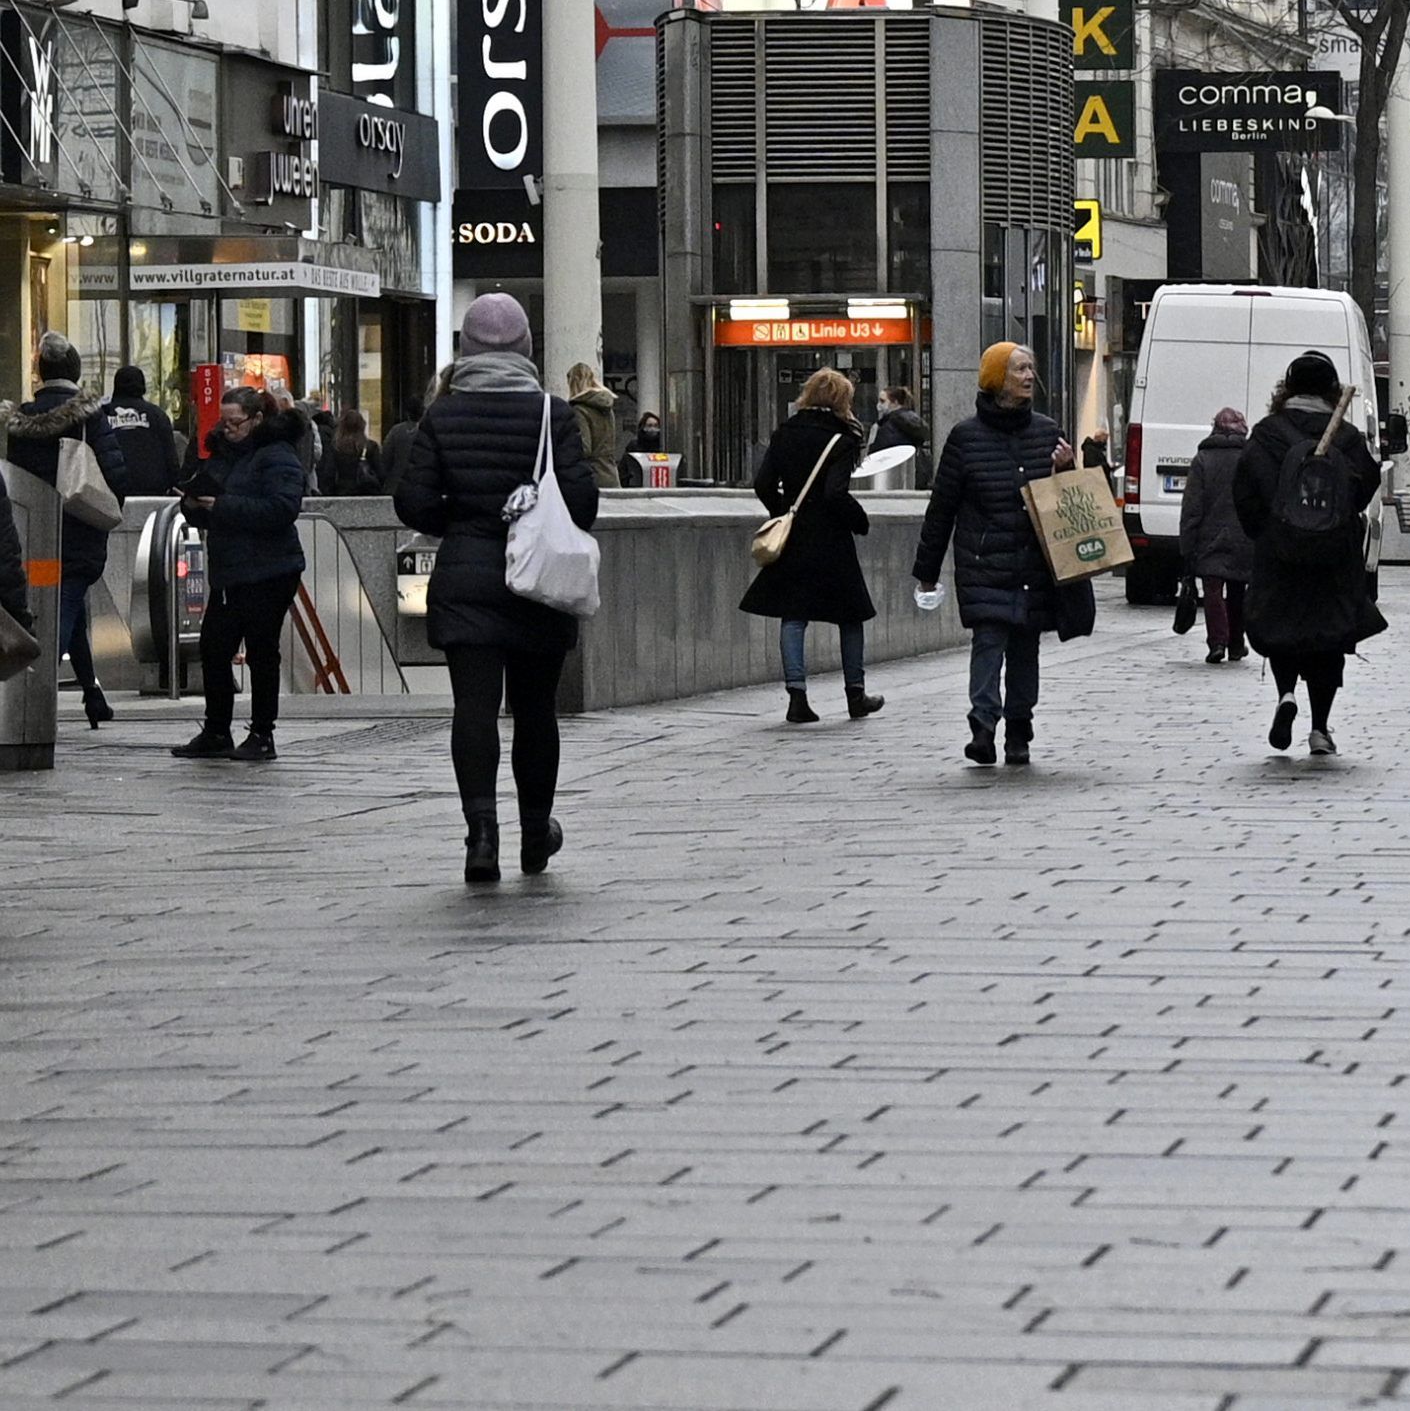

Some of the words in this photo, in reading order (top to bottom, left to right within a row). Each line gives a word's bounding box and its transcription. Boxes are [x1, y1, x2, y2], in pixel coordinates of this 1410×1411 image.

[284, 82, 318, 138] uhren
[1179, 118, 1317, 132] LIEBESKIND
[1231, 132, 1267, 141] Berlin
[360, 114, 405, 179] orsay
[258, 141, 319, 205] juwelen
[459, 222, 536, 243] SODA
[134, 268, 295, 285] www.villgraternatur.at
[811, 323, 846, 337] Linie
[850, 323, 870, 337] U3
[204, 369, 213, 404] STOP
[1078, 540, 1104, 555] GEA
